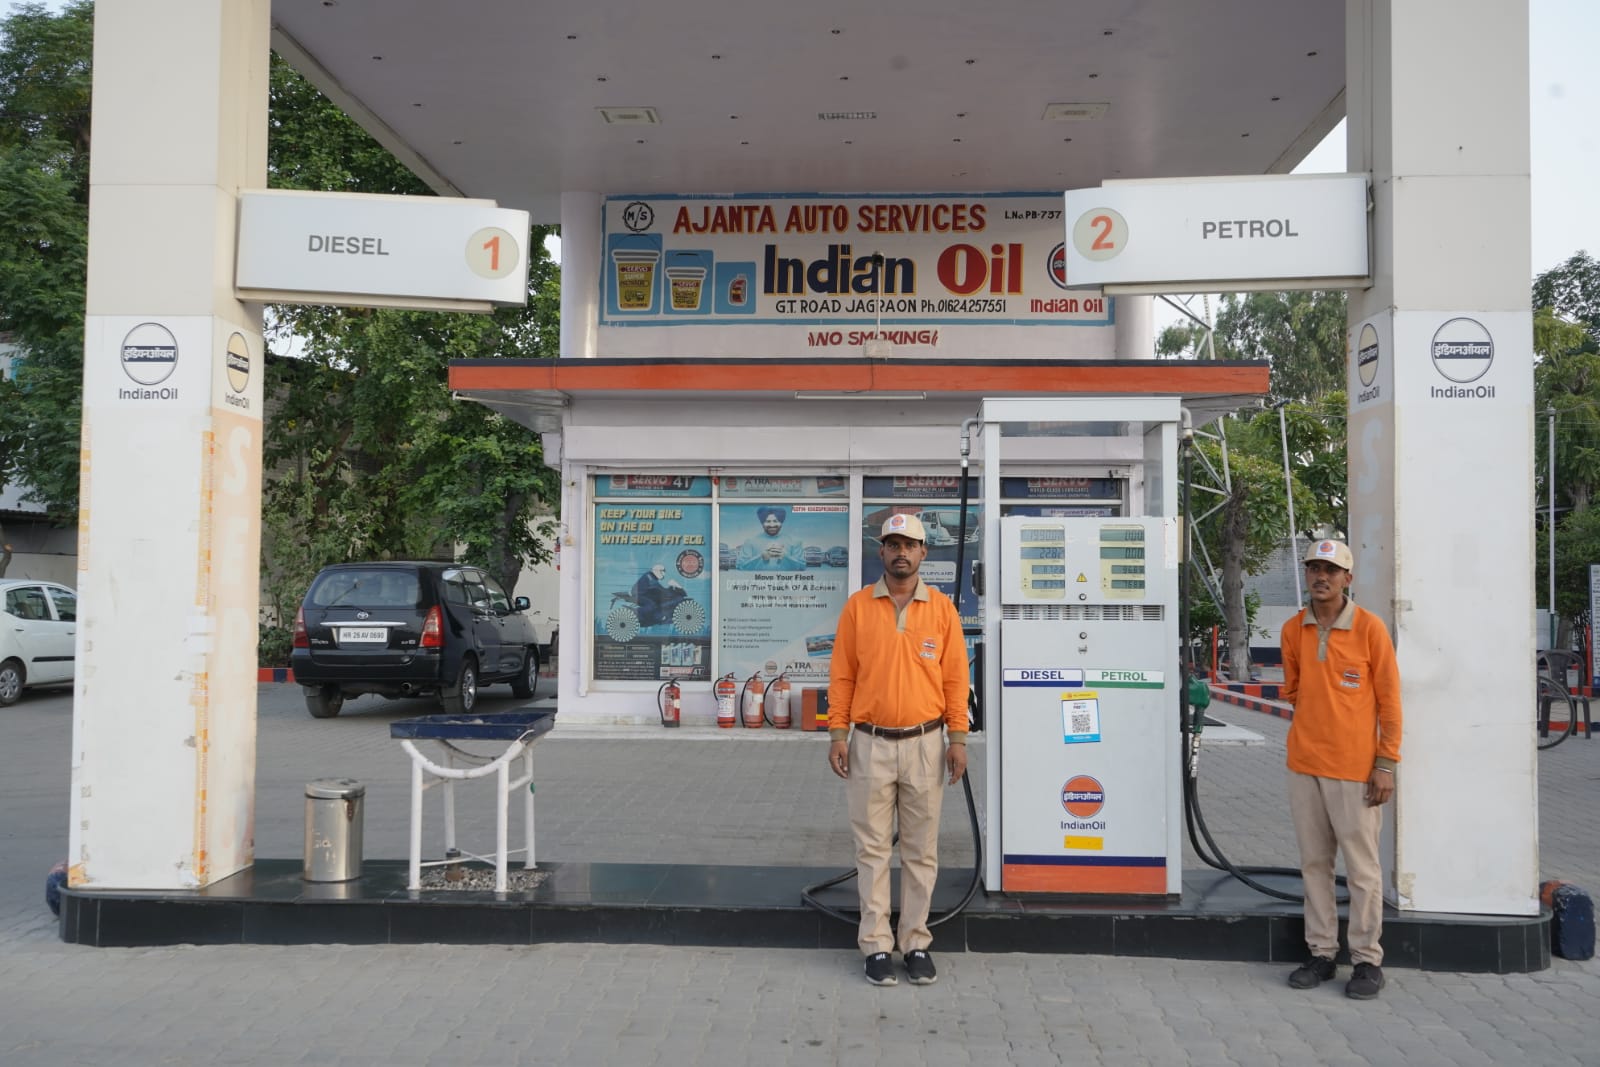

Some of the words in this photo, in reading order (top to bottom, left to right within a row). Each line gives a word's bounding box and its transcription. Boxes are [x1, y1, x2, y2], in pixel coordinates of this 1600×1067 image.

[673, 205, 777, 234] AJANTA
[784, 204, 849, 233] AUTO
[856, 203, 986, 232] SERVICES
[1090, 215, 1114, 251] 2
[1202, 219, 1299, 240] PETROL
[308, 234, 390, 256] DIESEL
[483, 235, 501, 271] 1
[763, 243, 916, 296] Indian
[936, 243, 1024, 296] Oil
[800, 299, 842, 313] ROAD
[1030, 298, 1079, 313] Indian
[814, 331, 843, 347] NO
[119, 388, 178, 400] IndianOil
[1431, 386, 1495, 399] IndianOil
[601, 509, 625, 519] KEEP
[630, 509, 656, 519] YOUR
[658, 509, 682, 519] BIKE
[600, 522, 615, 532] ON
[619, 522, 637, 532] THE
[601, 535, 629, 545] WITH
[631, 535, 662, 545] SUPER
[664, 535, 682, 545] FIT
[1021, 671, 1064, 680] DIESEL
[1101, 671, 1147, 681] PETROL
[1060, 821, 1106, 830] IndianOil
